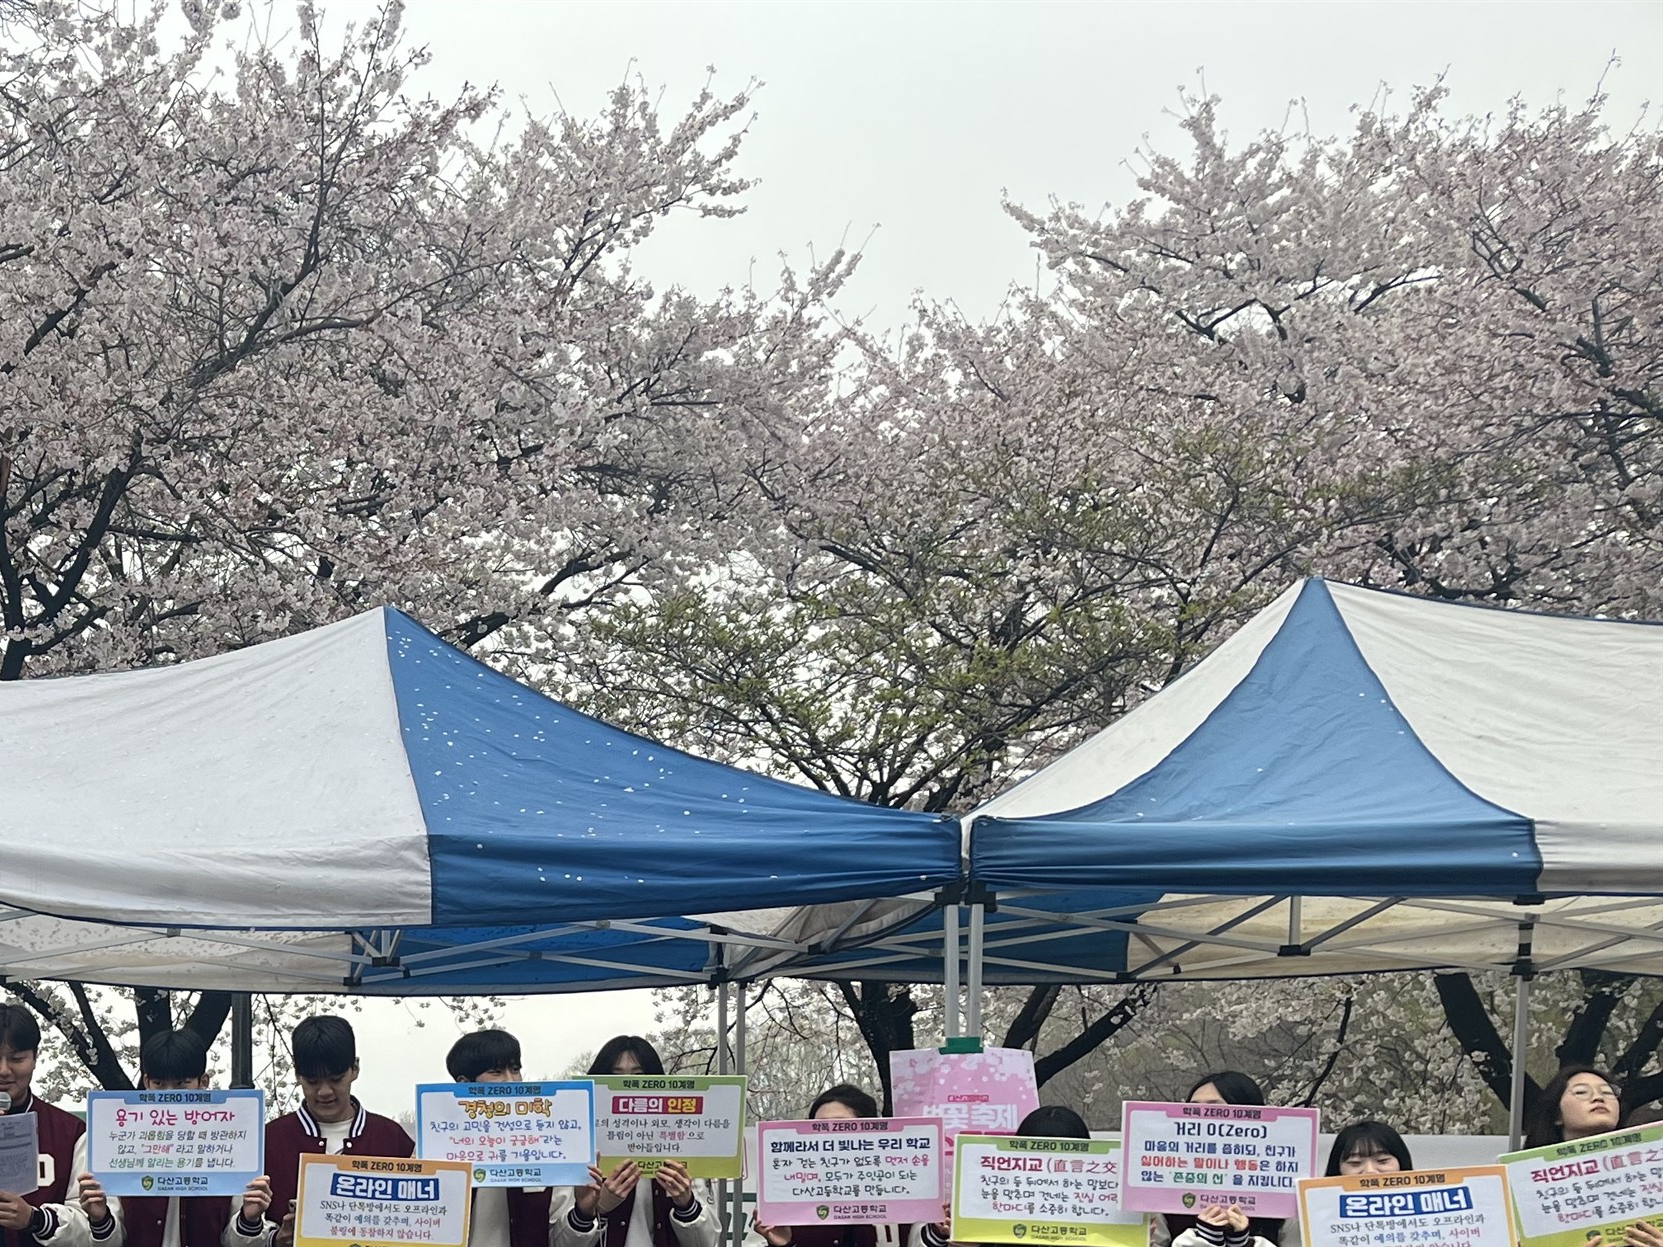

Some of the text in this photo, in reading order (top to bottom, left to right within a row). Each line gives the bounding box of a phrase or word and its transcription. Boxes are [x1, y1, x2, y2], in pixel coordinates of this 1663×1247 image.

[458, 1098, 552, 1118] 경청의 미학
[619, 1098, 696, 1113] 다름의 인정
[116, 1109, 235, 1127] 용기 있는 방어자
[431, 1122, 458, 1132] 친구의
[463, 1121, 490, 1131] 고민을
[495, 1120, 532, 1130] 건성으로
[833, 1123, 857, 1131] ZERO
[860, 1122, 888, 1131] 10계명
[1174, 1122, 1201, 1136] 거리
[109, 1131, 246, 1140] 누군가 괴롭힘을 당할 때 방관하지
[176, 1145, 194, 1154] 라고
[198, 1145, 233, 1154] 말하거나
[771, 1138, 930, 1152] 함께라서 더 빛나는 우리 학교
[1145, 1141, 1179, 1152] 마음의
[1184, 1142, 1217, 1153] 거리를
[1266, 1146, 1295, 1157] 친구가
[109, 1158, 145, 1168] 선생님께
[148, 1158, 173, 1168] 알리는
[177, 1158, 203, 1167] 용기를
[371, 1162, 394, 1171] ZERO
[397, 1163, 422, 1172] 10계명
[981, 1156, 1043, 1172] 직언지교
[1141, 1156, 1298, 1173] 싫어하는 말이나 행동은 하지
[1531, 1148, 1663, 1183] 직언지교 (直言之
[490, 1169, 541, 1177] 다산고등학교
[158, 1177, 208, 1185] 다산고등학교
[981, 1175, 1009, 1185] 친구의
[1027, 1177, 1059, 1187] 뒤에서
[1063, 1179, 1083, 1189] 하는
[1088, 1180, 1118, 1190] 말보다
[1383, 1177, 1410, 1186] ZERO
[1414, 1174, 1445, 1184] 10계명
[336, 1176, 435, 1199] 온라인 매너
[1200, 1195, 1255, 1205] 다산고등학교
[1346, 1189, 1467, 1217] 온라인 매너
[320, 1201, 447, 1214] SNS나 단톡방에서도 오프라인과
[834, 1205, 886, 1213] 다산고등학교
[325, 1214, 351, 1223] 똑같이
[354, 1215, 380, 1224] 예의를
[415, 1218, 441, 1227] 사이버
[330, 1227, 356, 1236] 불링에
[360, 1228, 393, 1237] 동참하지
[1031, 1225, 1087, 1235] 다산고등학교
